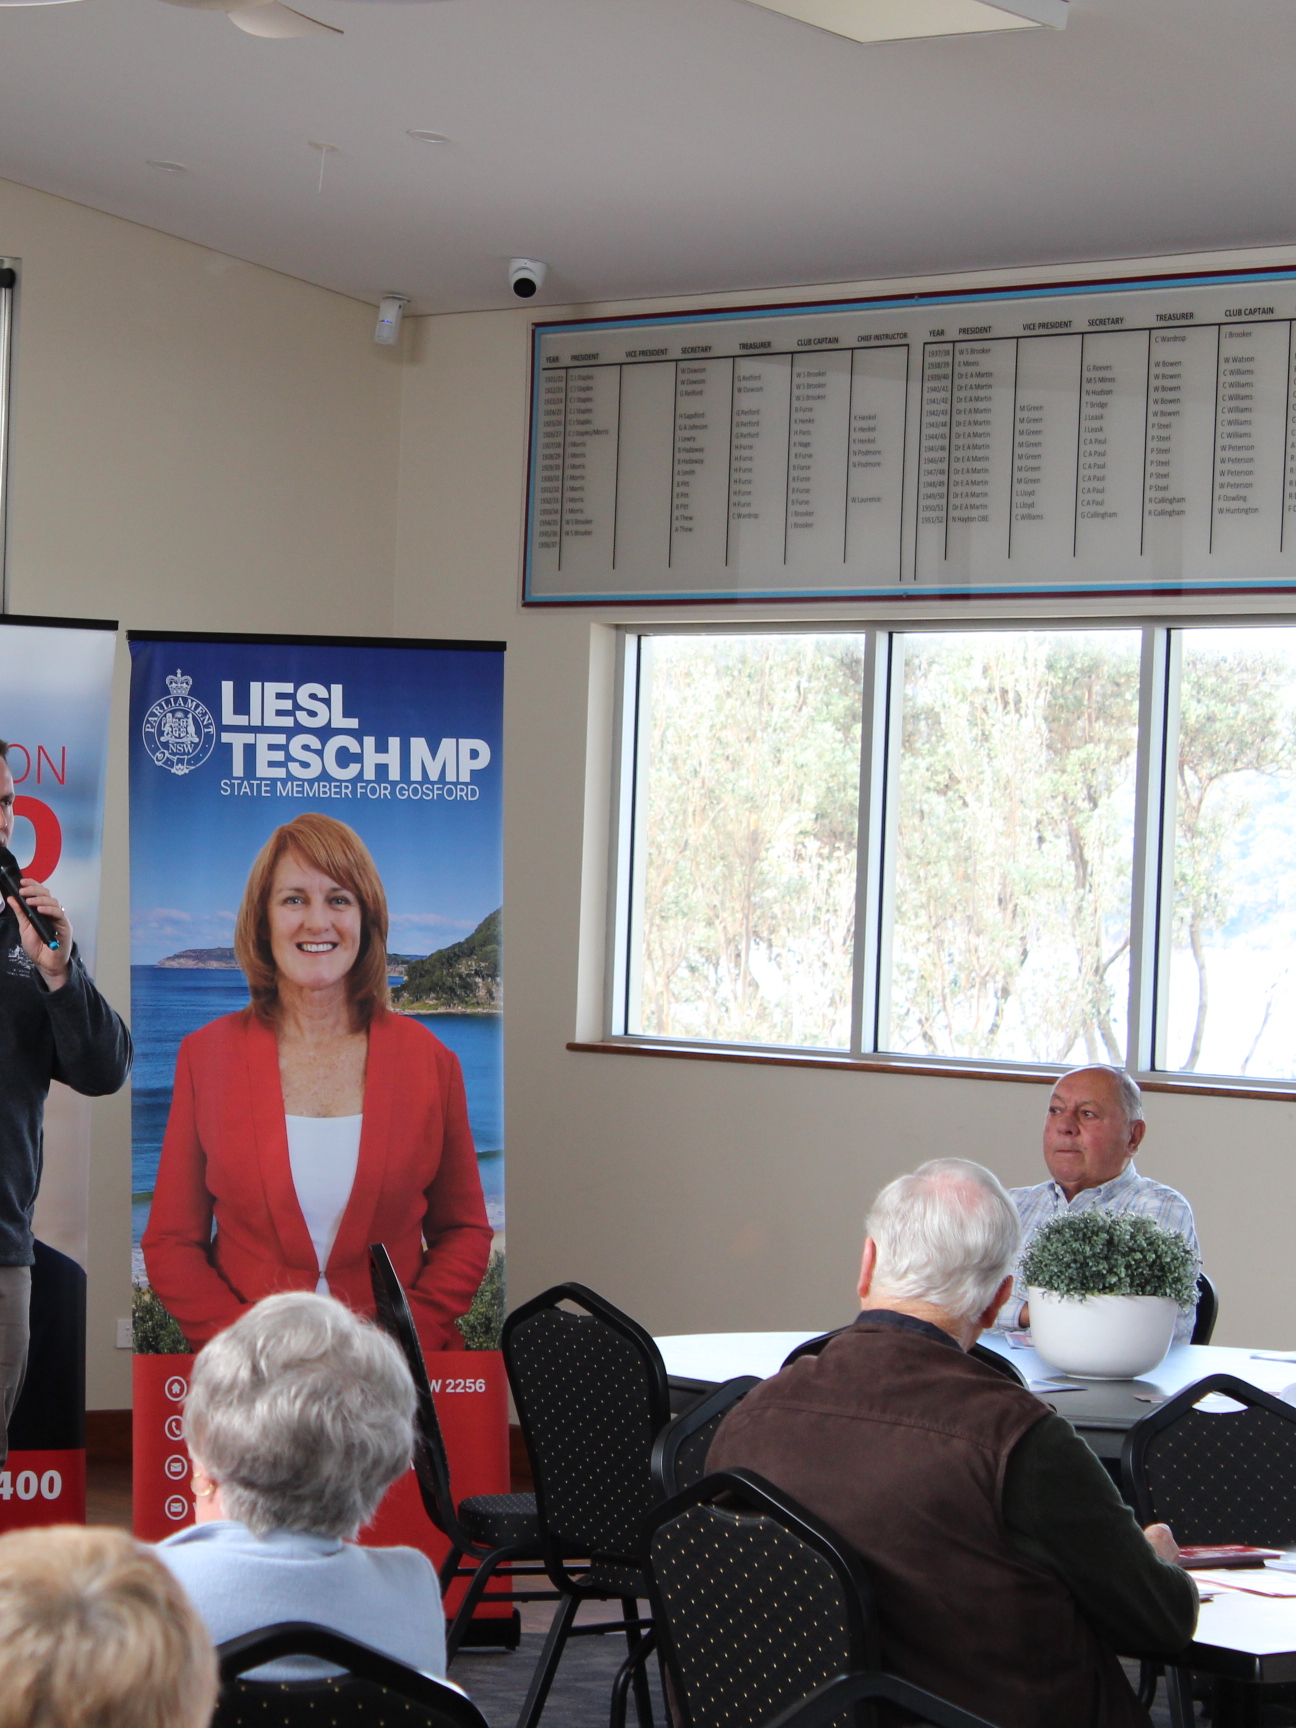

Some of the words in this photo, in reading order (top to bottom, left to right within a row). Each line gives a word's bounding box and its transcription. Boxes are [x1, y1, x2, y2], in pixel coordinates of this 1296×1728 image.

[1156, 312, 1194, 321] TREASURER
[1224, 308, 1242, 317] CLUB
[1243, 308, 1274, 316] CAPTAIN
[1037, 320, 1072, 330] PRESIDENT
[1087, 317, 1124, 326] SECRETARY
[958, 326, 991, 335] PRESIDENT
[797, 338, 812, 346] CLUB
[813, 336, 838, 345] CAPTAIN
[857, 334, 872, 342] CHIEF
[873, 332, 908, 341] INSTRUCTOR
[681, 346, 712, 354] SECRETARY
[739, 341, 771, 350] TREASURER
[570, 353, 599, 362] PRESIDENT
[625, 350, 637, 358] VICE
[638, 348, 668, 357] PRESIDENT
[221, 680, 359, 729] LIESL
[144, 695, 215, 735] PARLIAMENT
[167, 743, 195, 754] NSW
[220, 732, 401, 781] TESCH
[410, 737, 491, 783] MP
[220, 779, 271, 796] STATE
[276, 781, 353, 799] MEMBER
[357, 783, 391, 799] FOR
[396, 783, 480, 801] GOSFORD
[445, 1379, 486, 1393] 2256
